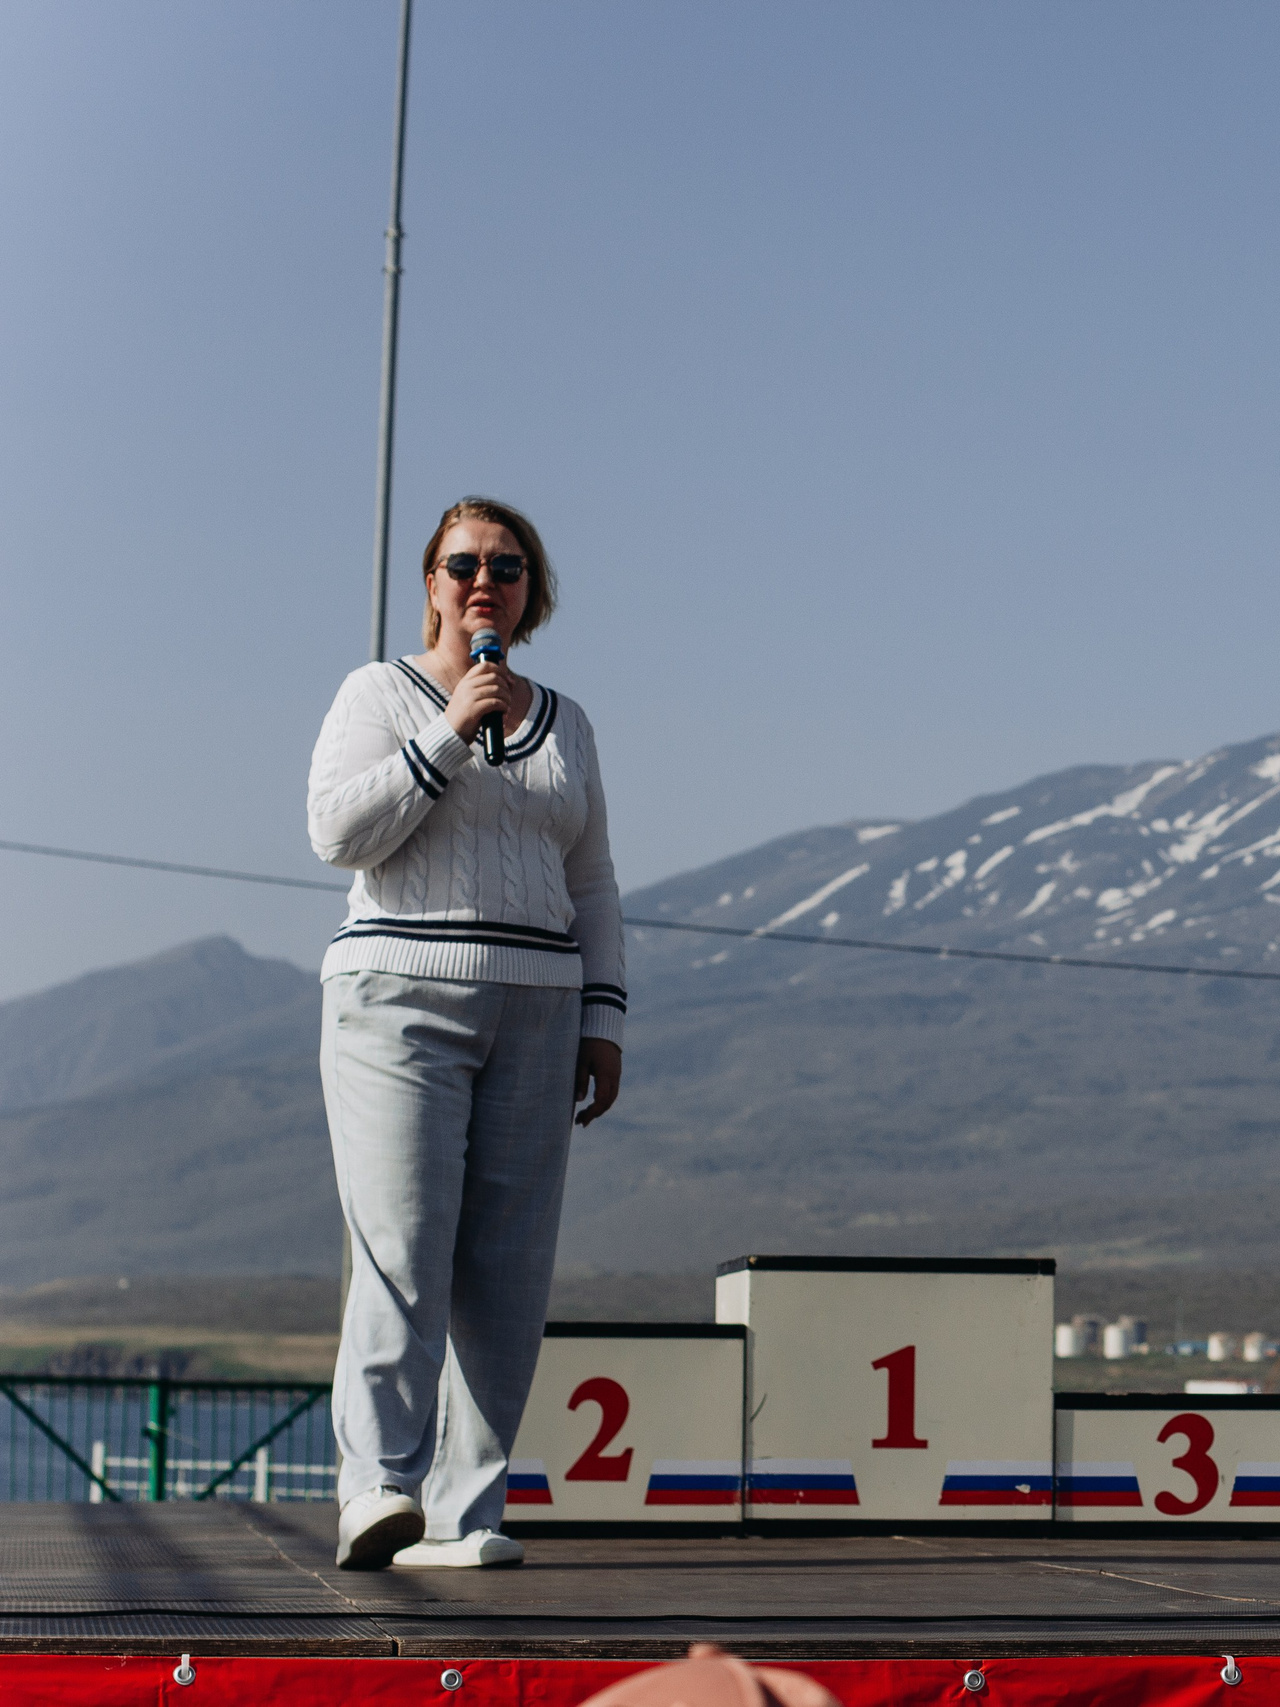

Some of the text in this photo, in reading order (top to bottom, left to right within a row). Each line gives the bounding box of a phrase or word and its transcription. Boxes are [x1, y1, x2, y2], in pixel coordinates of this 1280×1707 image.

[565, 1376, 634, 1482] 2
[871, 1345, 929, 1449] 1
[1154, 1412, 1219, 1516] 3
